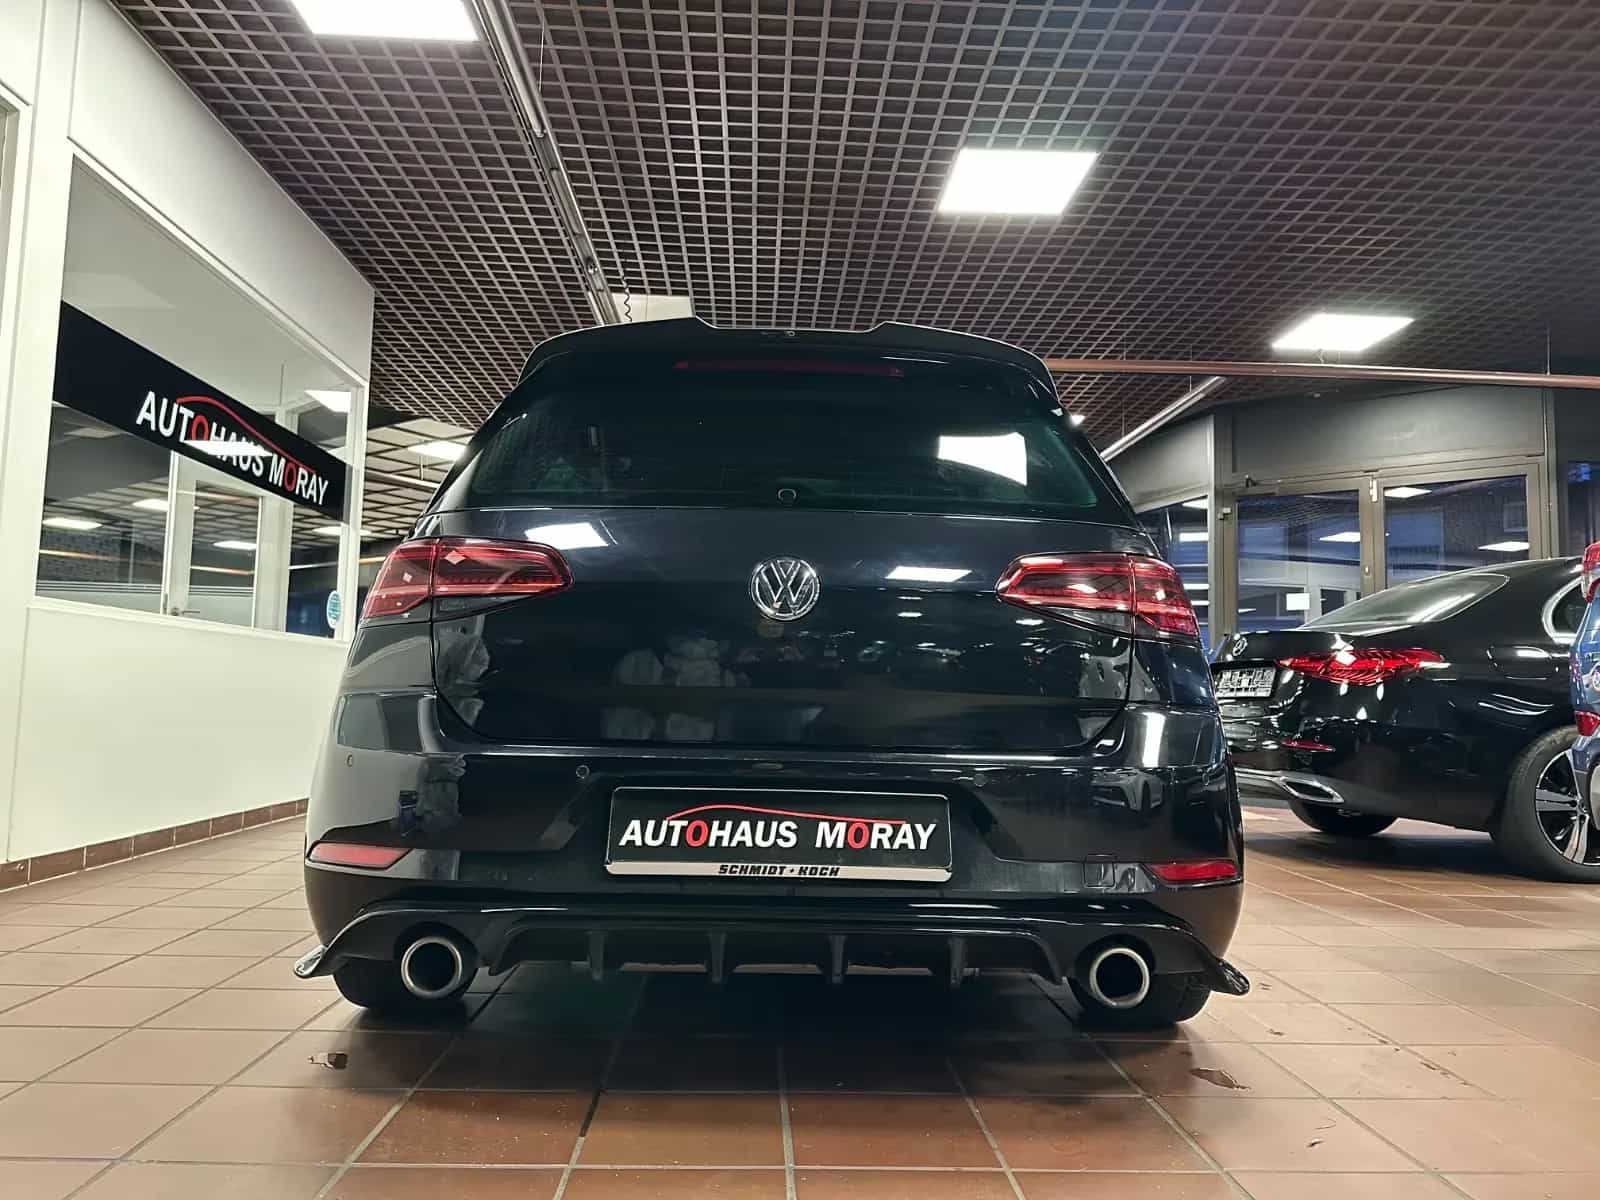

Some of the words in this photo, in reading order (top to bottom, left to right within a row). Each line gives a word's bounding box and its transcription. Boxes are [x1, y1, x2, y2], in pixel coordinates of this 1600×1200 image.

[136, 391, 265, 478] AUTOHAUS
[268, 453, 329, 505] MORAY
[752, 558, 819, 620] VW
[619, 819, 798, 848] AUTOHAUS
[815, 822, 937, 850] MORAY
[718, 864, 787, 876] SCHMIDT
[798, 866, 841, 877] KOCH
